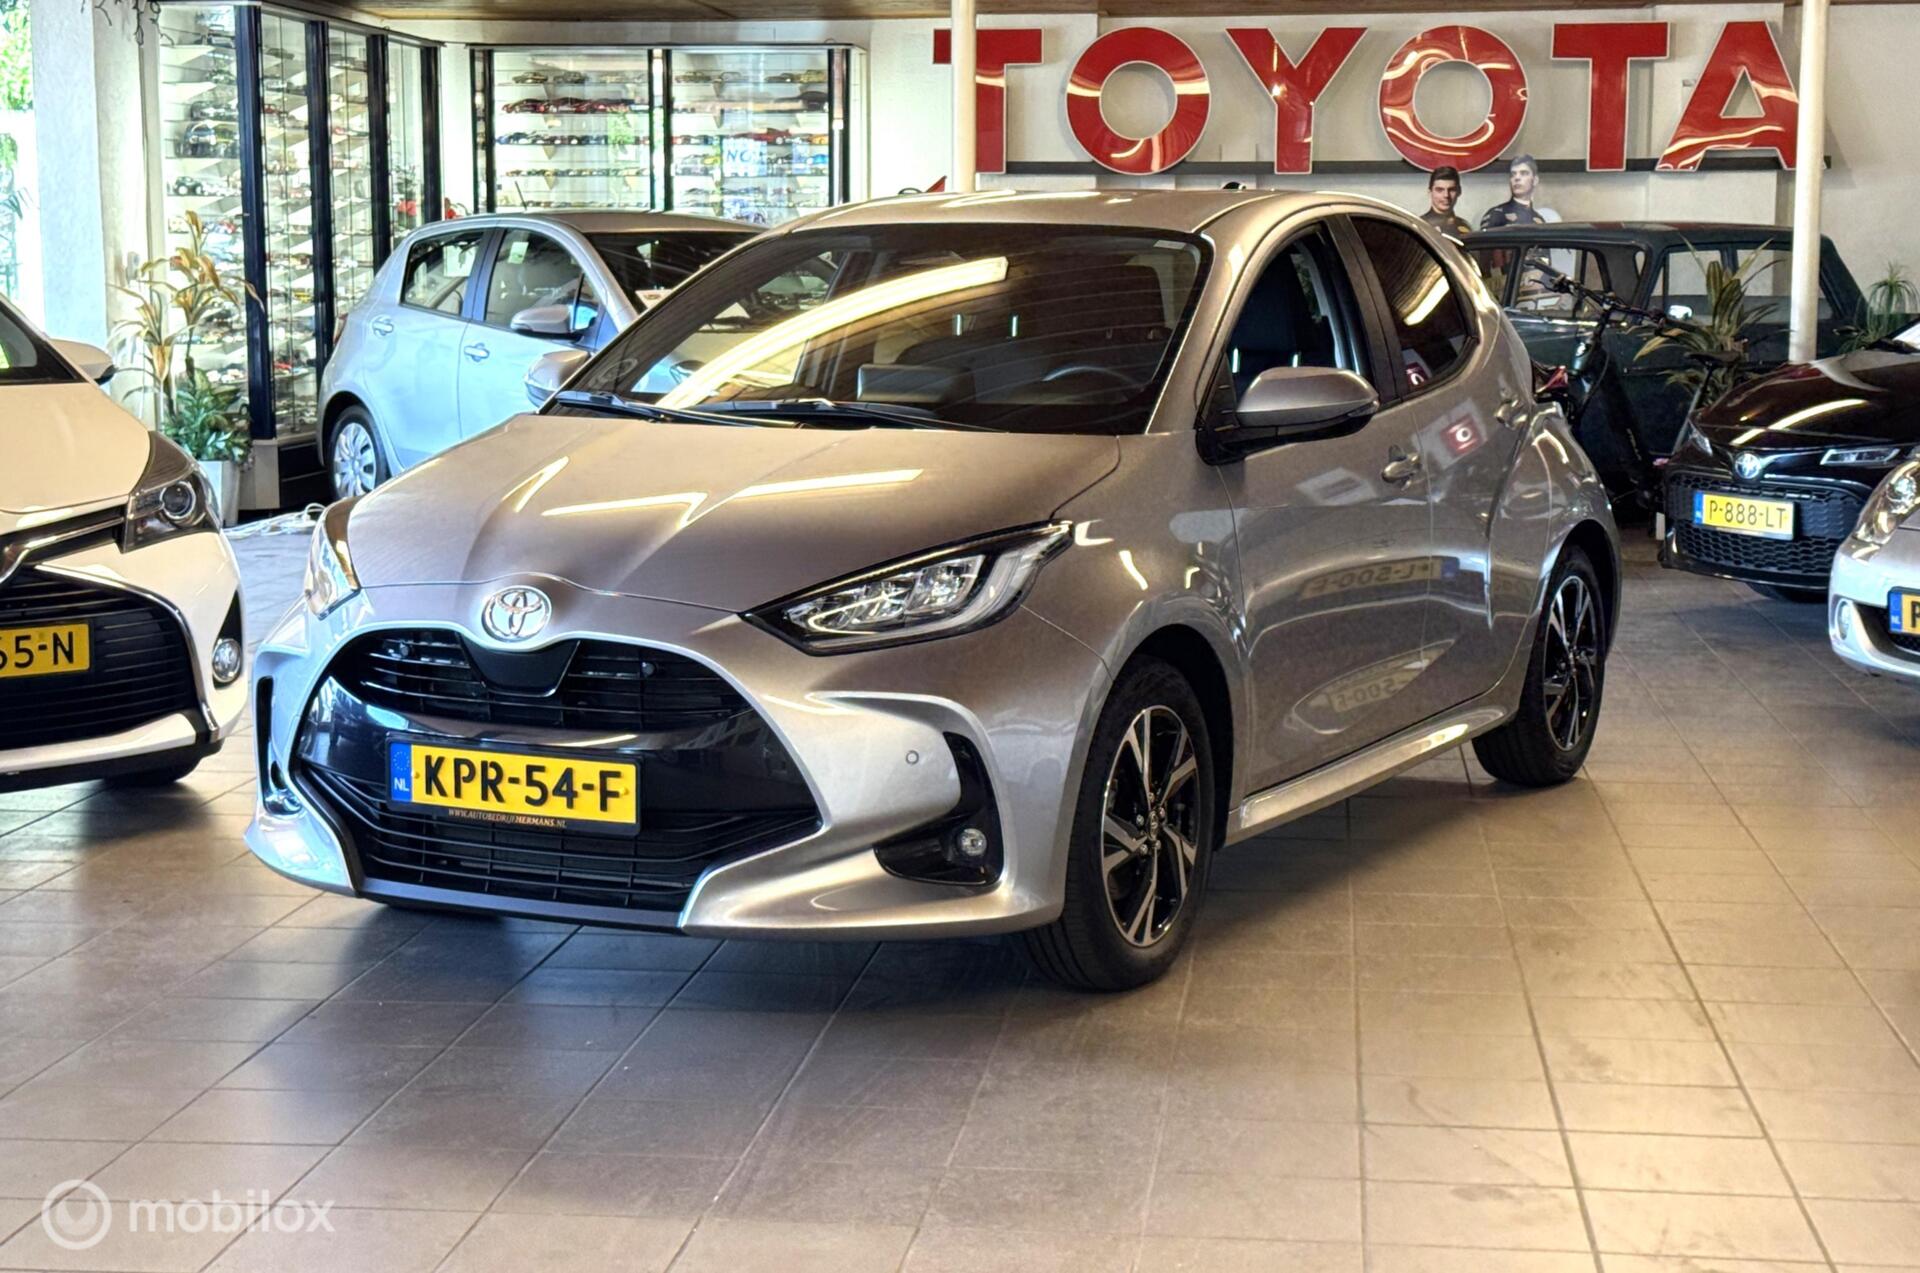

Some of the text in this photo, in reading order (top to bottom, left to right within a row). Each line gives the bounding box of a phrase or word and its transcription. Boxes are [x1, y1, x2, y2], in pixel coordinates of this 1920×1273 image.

[932, 21, 1798, 175] TOYOTA
[1709, 500, 1786, 529] P-888-LT
[393, 777, 410, 793] NL
[424, 754, 622, 812] KPR-54-F
